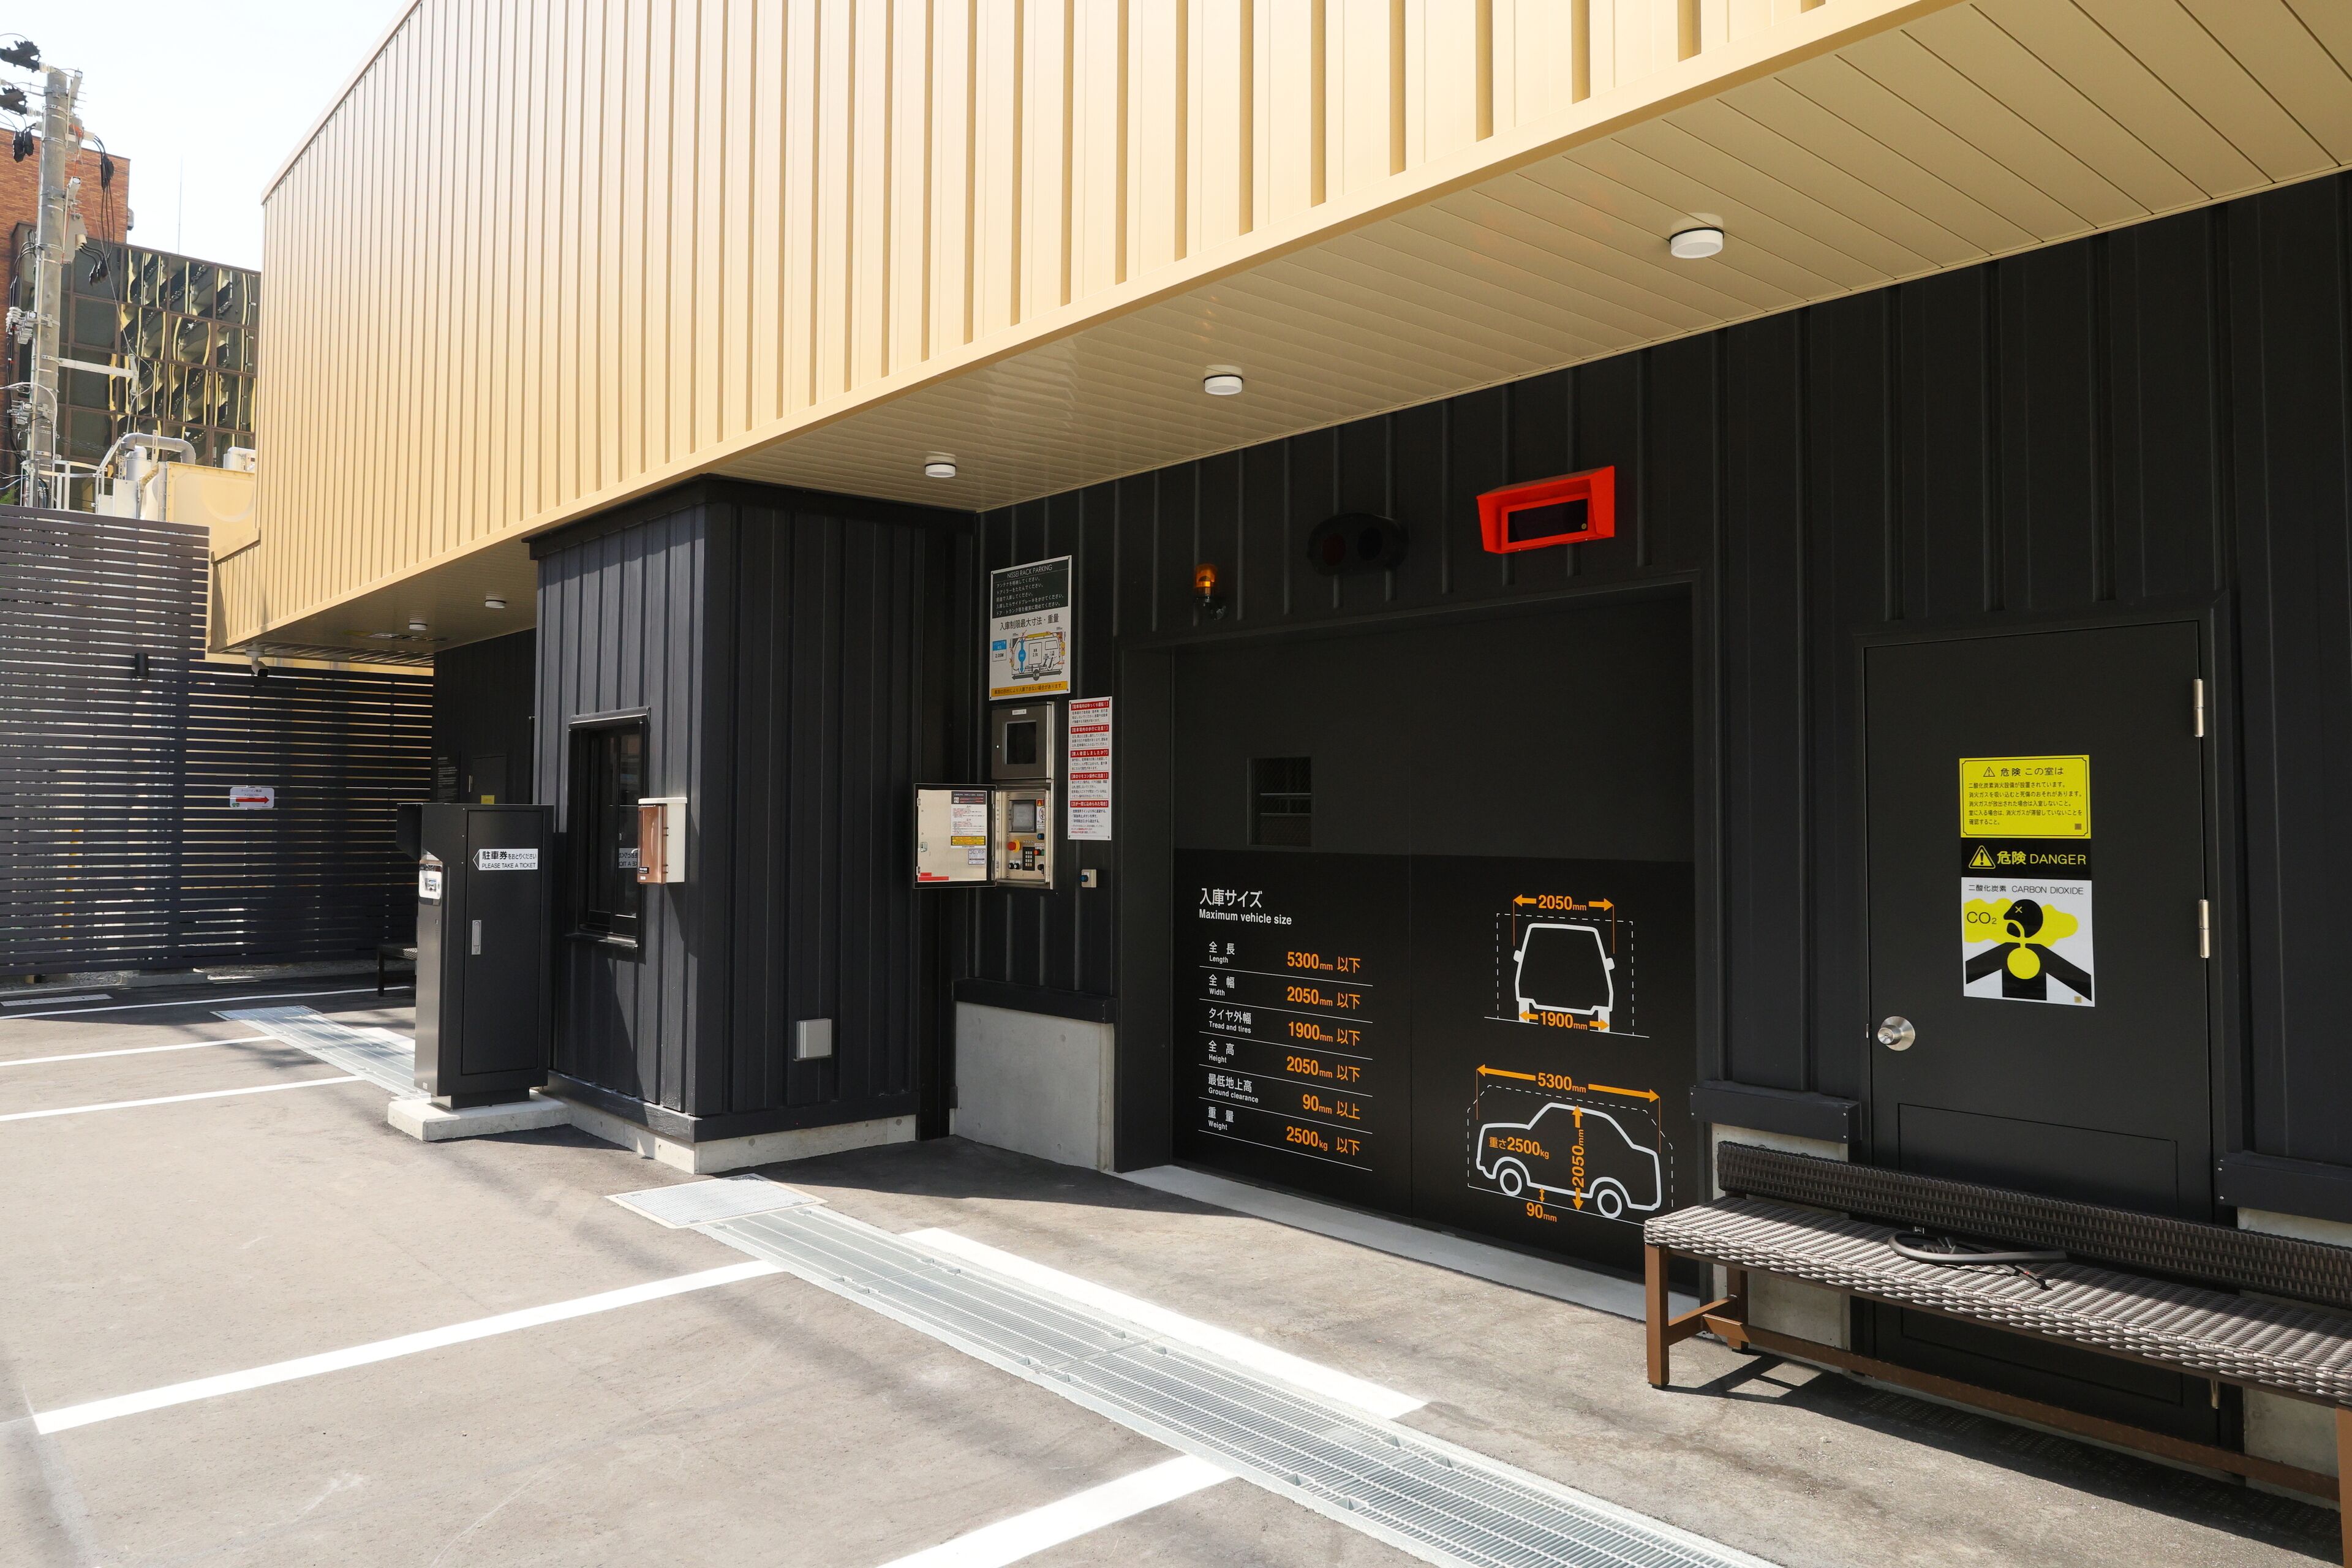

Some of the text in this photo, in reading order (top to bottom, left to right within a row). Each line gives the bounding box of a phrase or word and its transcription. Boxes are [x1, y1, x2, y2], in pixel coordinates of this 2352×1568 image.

[1033, 564, 1053, 574] PARKING
[1000, 613, 1059, 631] 入庫制限最大寸法・重量
[2000, 767, 2064, 777] 危険 この室は
[481, 851, 537, 860] 駐車券をおとりください
[1997, 851, 2086, 865] 危険 DANGER
[1199, 888, 1263, 908] 入庫サイズ
[2012, 885, 2047, 894] CARBON
[1538, 894, 1587, 911] 2050mm
[1199, 908, 1292, 925] Maximum vehicle size
[1209, 955, 1229, 965] Length
[1287, 951, 1361, 973] 5300mm 以下
[1209, 988, 1225, 997] Width
[1287, 986, 1360, 1009] 2050mm 以下
[1208, 1008, 1251, 1025] タイヤ外幅
[1540, 1011, 1588, 1030] 1900mm
[1208, 1021, 1225, 1030] Tread
[1238, 1025, 1251, 1034] tires
[1288, 1021, 1360, 1046] 1900mm 以下
[1208, 1054, 1227, 1063] Height
[1286, 1056, 1360, 1082] 2050mm 以下
[1208, 1073, 1252, 1093] 最低地上高
[1537, 1072, 1586, 1093] 5300mm
[1208, 1087, 1259, 1104] Ground clearance
[1303, 1094, 1360, 1120] 90mm 以上
[1208, 1120, 1227, 1131] Weight
[1286, 1126, 1360, 1156] 2500kg 以下
[1572, 1129, 1585, 1188] 2050mm
[1526, 1202, 1558, 1222] 90mm
